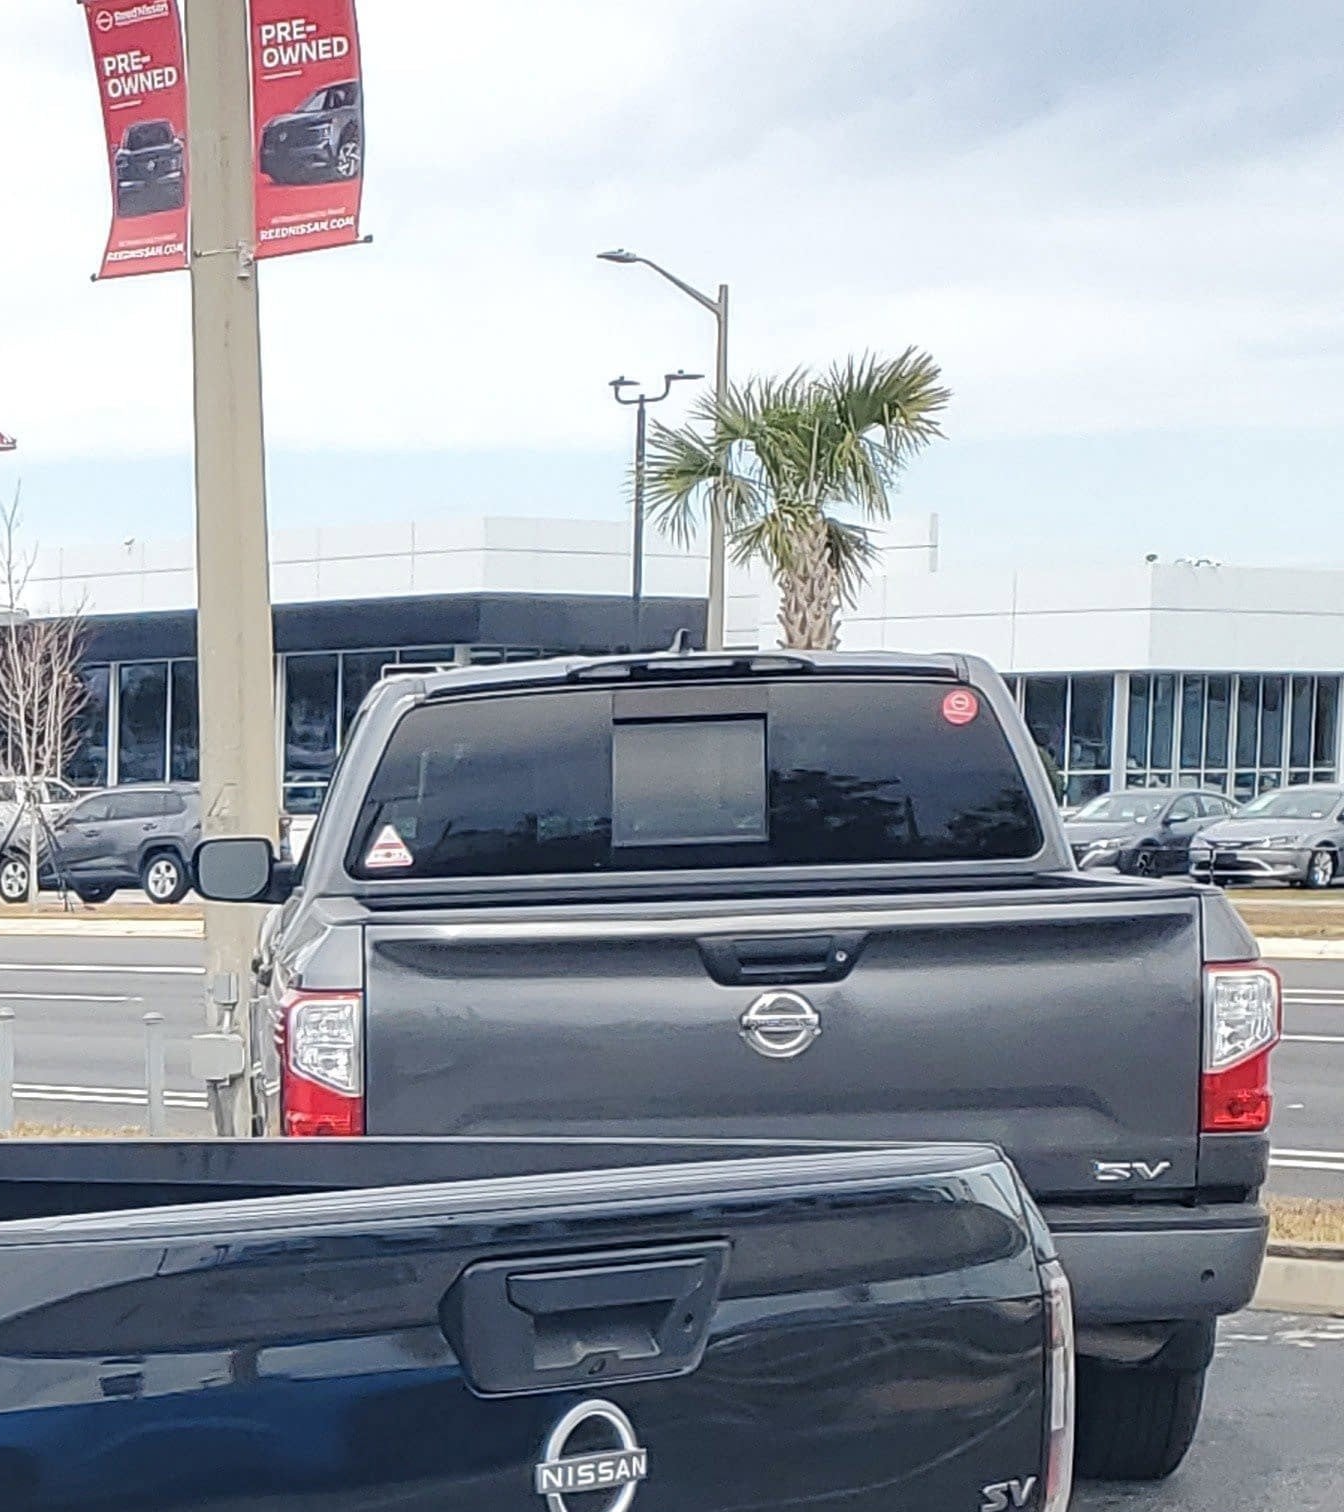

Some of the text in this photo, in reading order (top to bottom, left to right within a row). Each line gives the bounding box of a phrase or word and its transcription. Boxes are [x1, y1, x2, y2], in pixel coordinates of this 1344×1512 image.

[259, 18, 316, 46] PRE-
[103, 50, 151, 76] PRE-
[263, 36, 349, 68] OWNED
[108, 66, 177, 97] OWNED
[1095, 1161, 1171, 1180] SV
[541, 1454, 646, 1490] NISSAN
[981, 1476, 1037, 1512] SV
